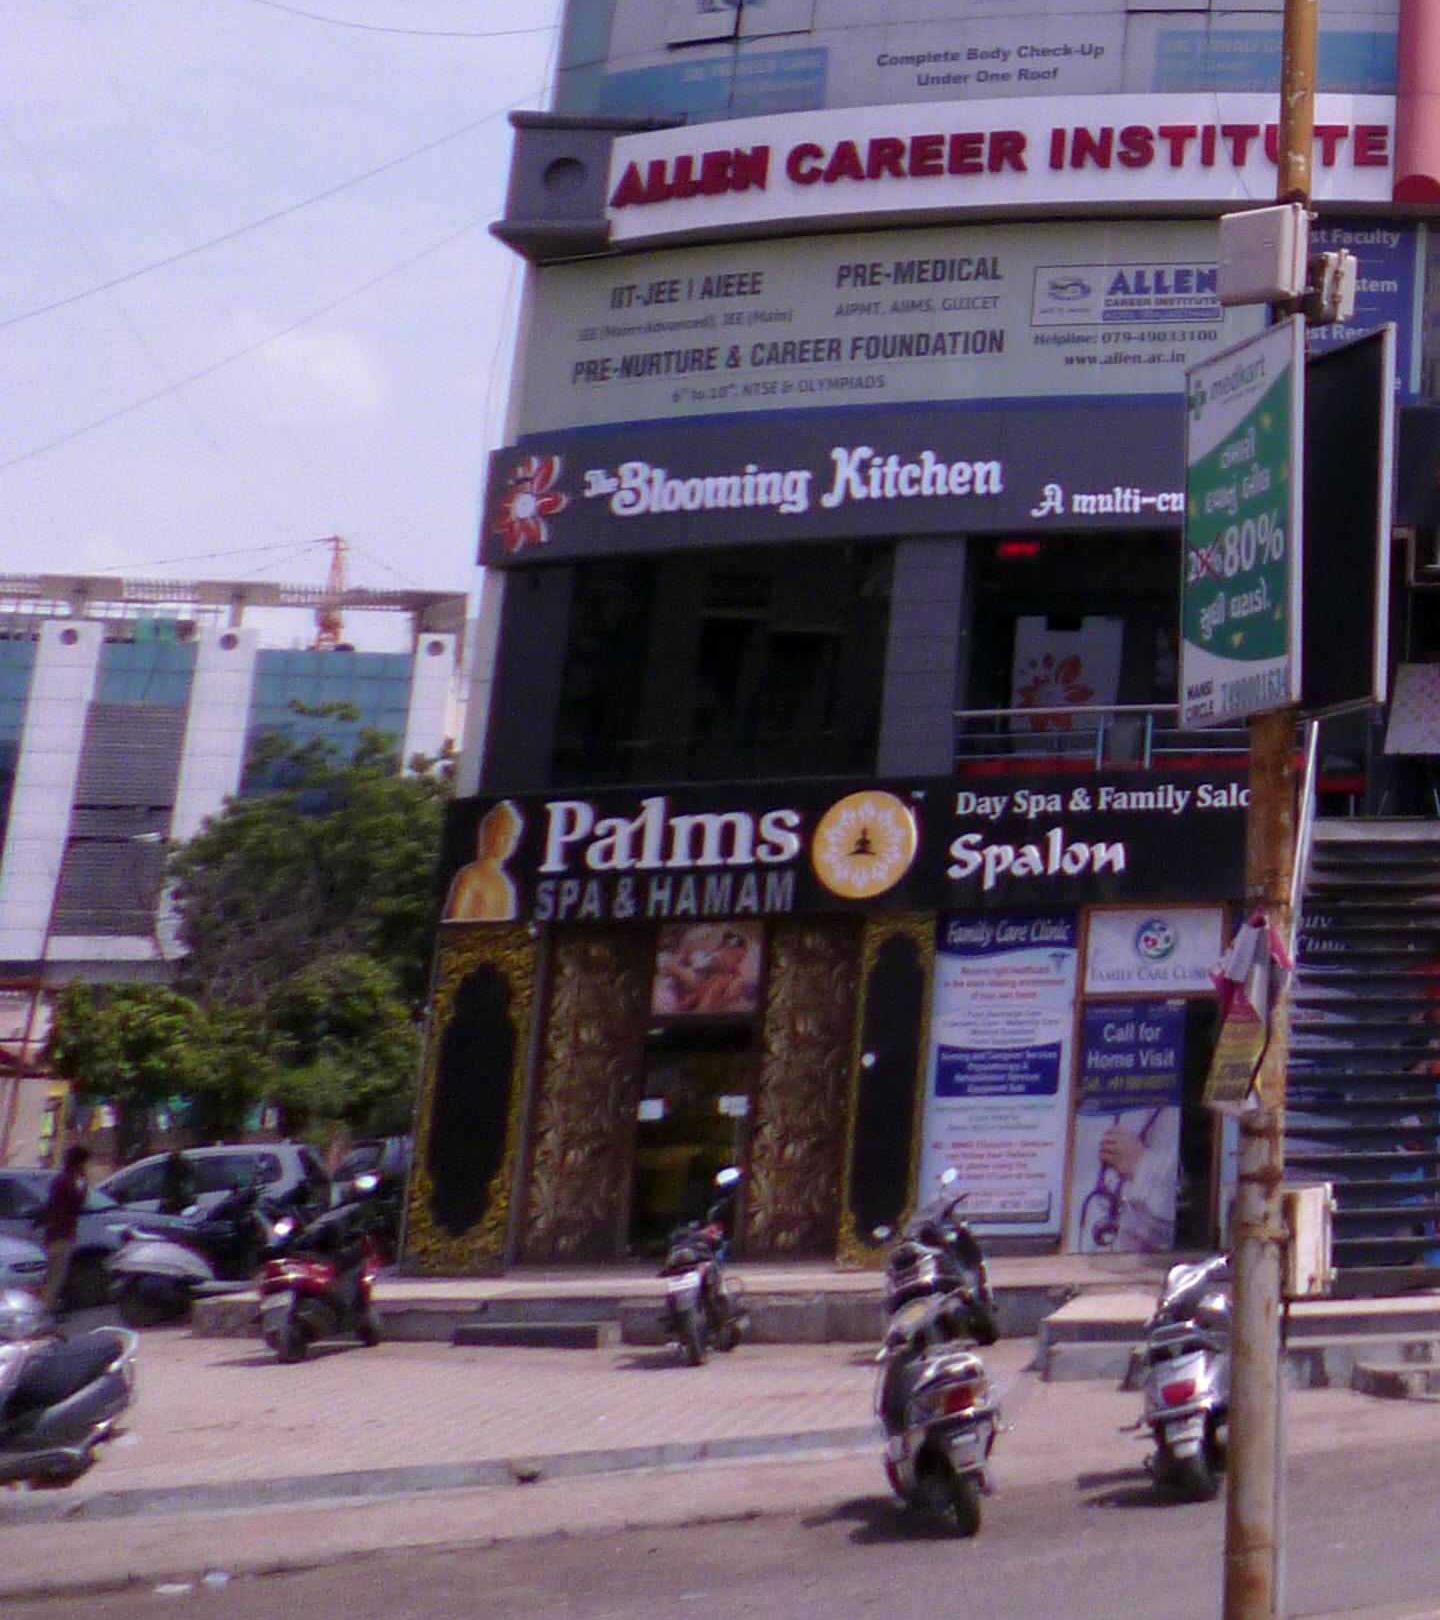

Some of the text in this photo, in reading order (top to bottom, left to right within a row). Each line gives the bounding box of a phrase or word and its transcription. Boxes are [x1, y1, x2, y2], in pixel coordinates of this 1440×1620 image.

[876, 42, 1105, 68] Complete Body Check-Up
[916, 67, 1058, 87] Under One Roof
[610, 144, 770, 208] ALLEN
[786, 130, 1027, 186] CAREER
[1331, 229, 1400, 248] Faculty
[700, 271, 764, 300] AIEEE
[835, 256, 1003, 289] PRE-MEDICAL
[1106, 268, 1218, 296] ALLEN
[572, 329, 1004, 384] PRE-NURTURE & CAREER FOUNDATION
[1211, 355, 1267, 400] medkart
[611, 461, 812, 517] Blooming
[820, 446, 1004, 510] Kitchen
[1030, 483, 1186, 518] A multi-cu
[1223, 509, 1284, 577] 80%
[956, 791, 1008, 820] Day
[1013, 789, 1062, 819] Spa
[1068, 787, 1092, 811] &
[1098, 785, 1191, 814] Family
[538, 795, 802, 873] Palms
[947, 826, 1127, 891] Spalon
[535, 870, 797, 921] SPA & HAMAM
[947, 918, 1072, 948] Family Care Clinic
[1103, 1021, 1162, 1042] Call for
[1087, 1048, 1175, 1070] Home Visit
